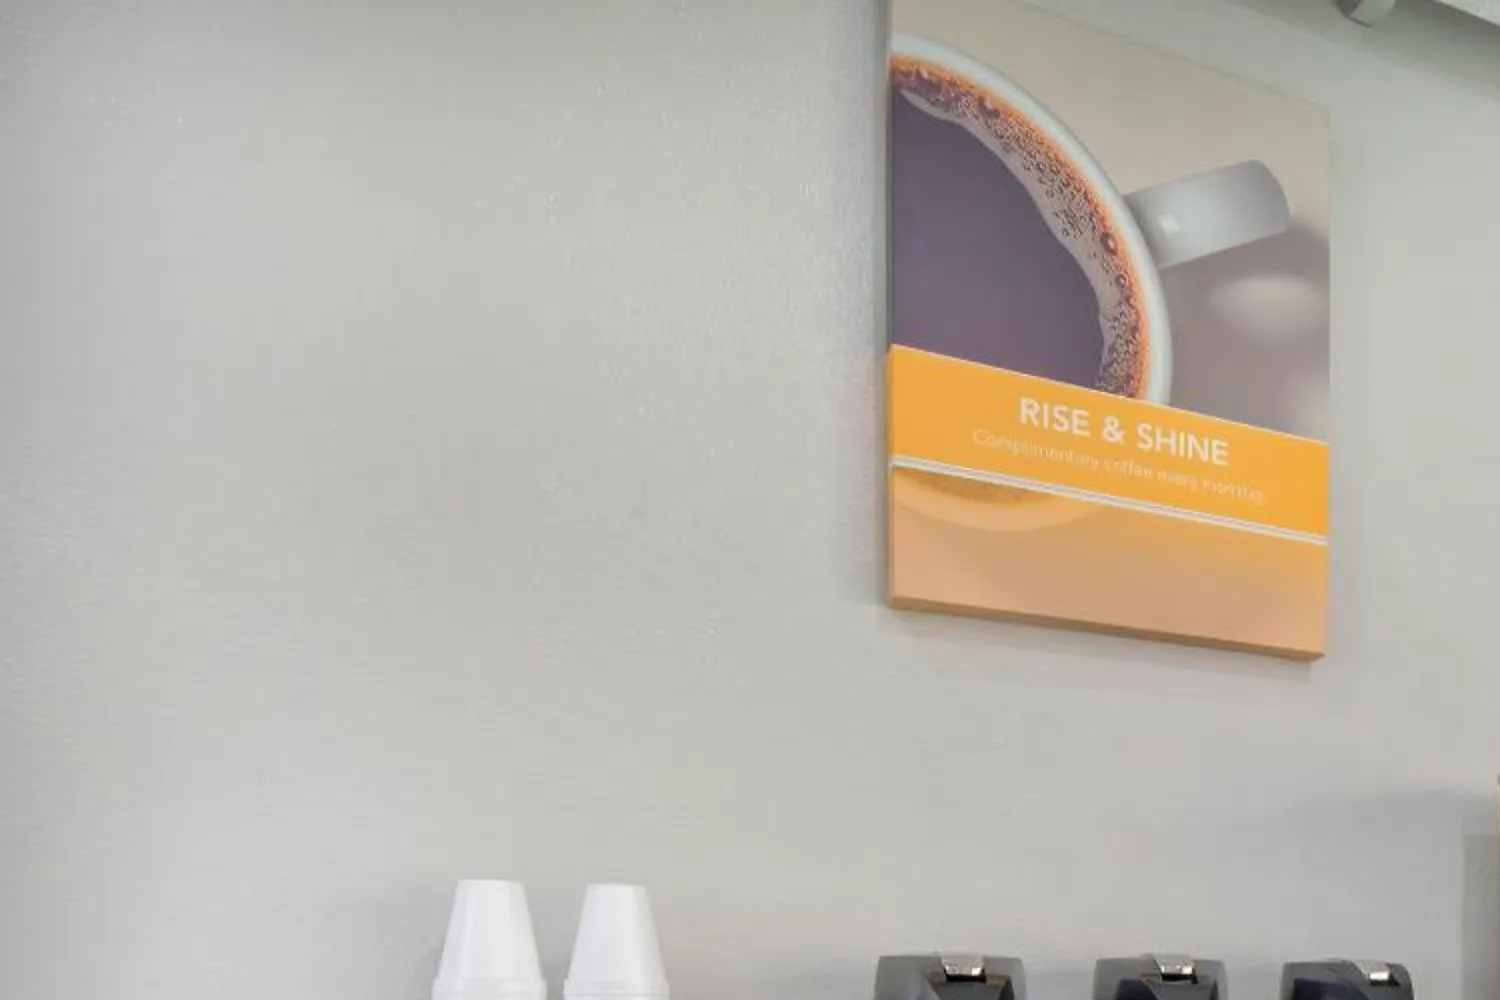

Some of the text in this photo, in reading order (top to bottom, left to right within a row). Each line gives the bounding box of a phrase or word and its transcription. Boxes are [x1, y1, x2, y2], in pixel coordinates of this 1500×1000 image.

[973, 429, 1099, 471] Complimentary
[1020, 397, 1229, 466] RISE & SHINE
